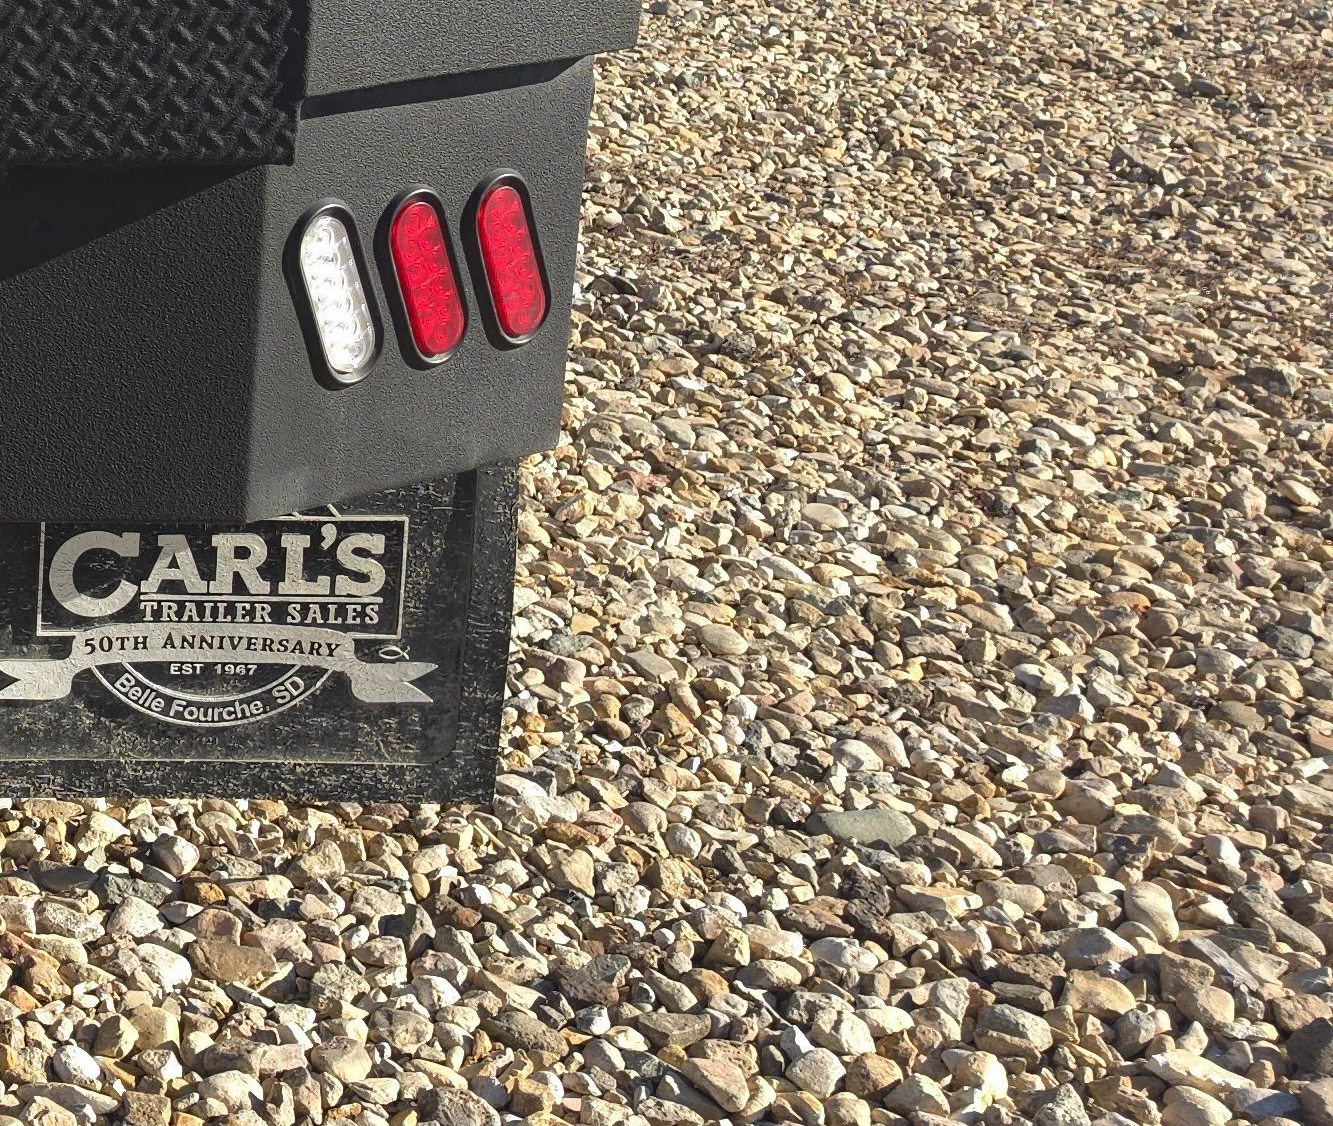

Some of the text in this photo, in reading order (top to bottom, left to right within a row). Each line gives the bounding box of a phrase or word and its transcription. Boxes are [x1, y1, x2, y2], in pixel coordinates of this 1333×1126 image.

[48, 523, 387, 618] CARL'S
[139, 601, 381, 625] TRAILER SALES
[84, 631, 343, 659] 50TH ANNIVERSARY
[213, 663, 258, 677] 1967
[113, 672, 166, 713] Belle
[271, 675, 306, 706] SD
